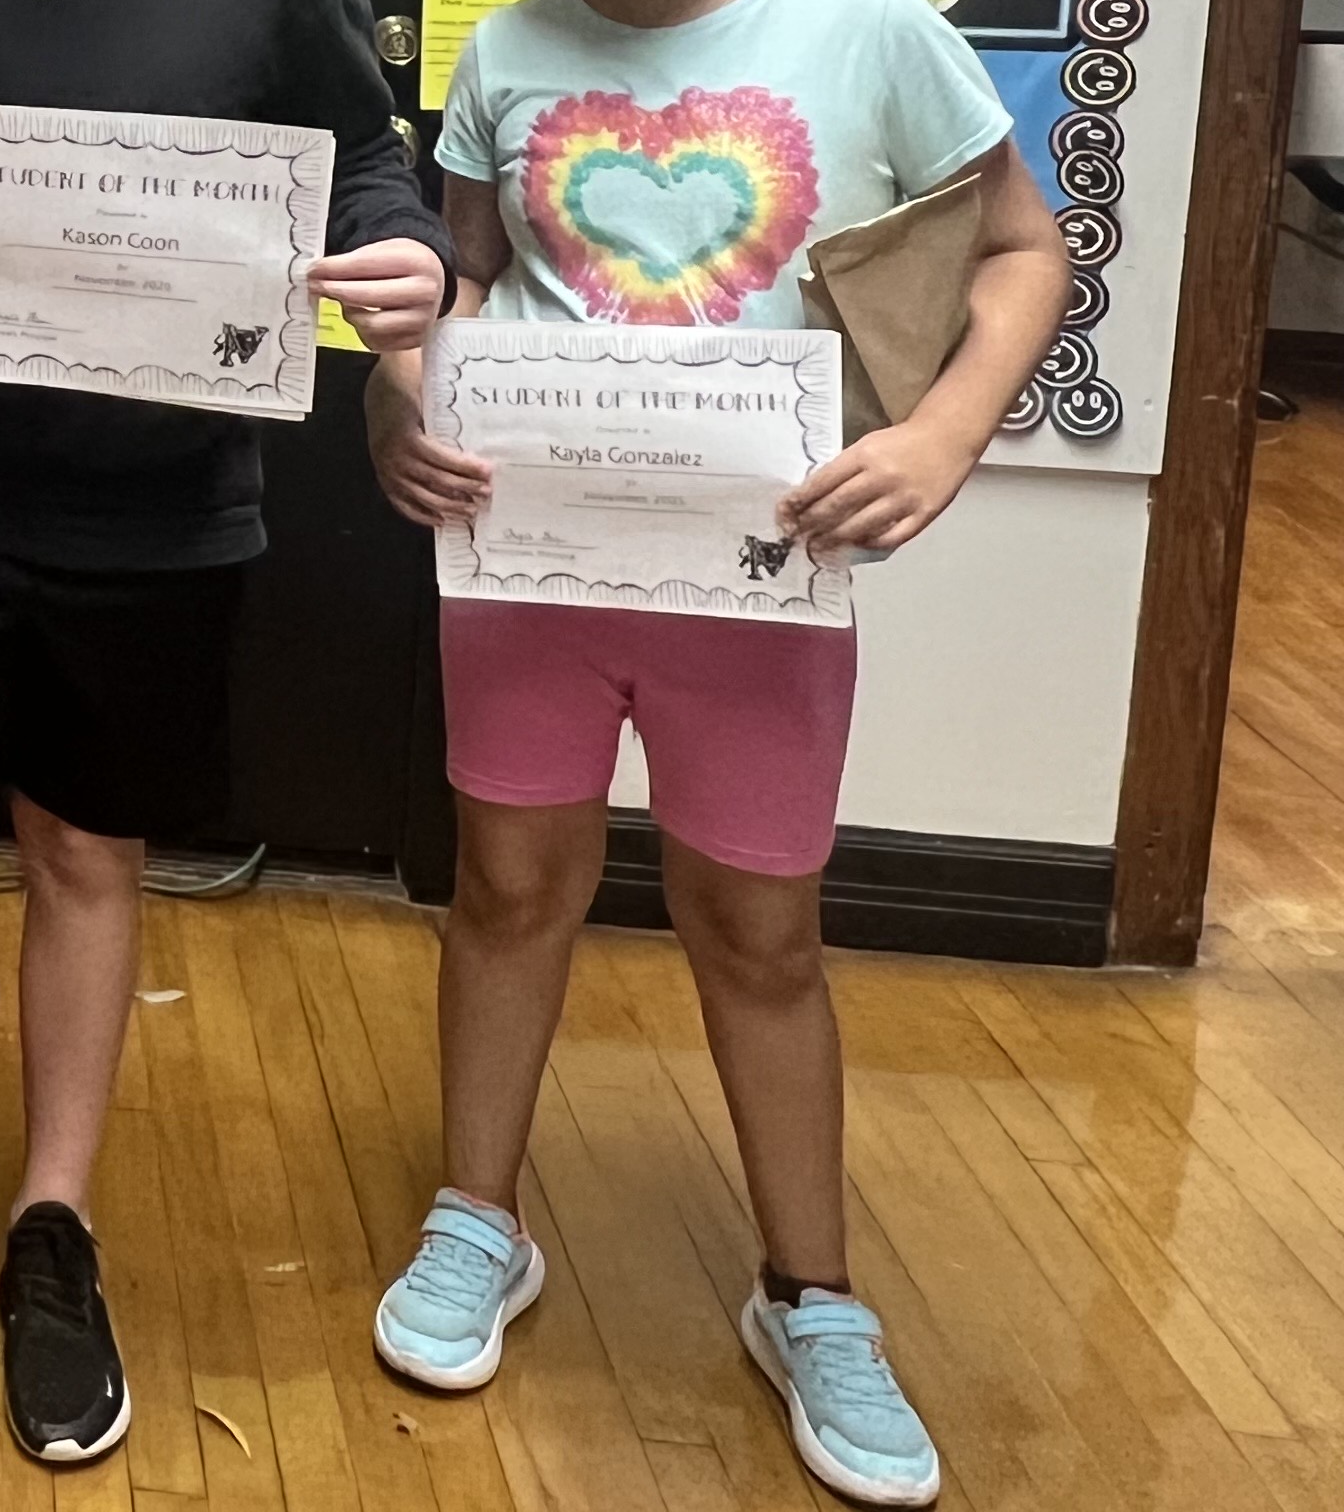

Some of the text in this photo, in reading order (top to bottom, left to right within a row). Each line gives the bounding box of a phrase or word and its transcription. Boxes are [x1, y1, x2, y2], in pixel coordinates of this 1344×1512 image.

[98, 172, 127, 193] OF
[140, 174, 189, 197] THE
[192, 178, 282, 204] MONTH
[62, 227, 181, 252] Kason Coon
[470, 387, 789, 413] STUDENT OF THE MONTH
[548, 444, 704, 467] Kayla Gonzalez
